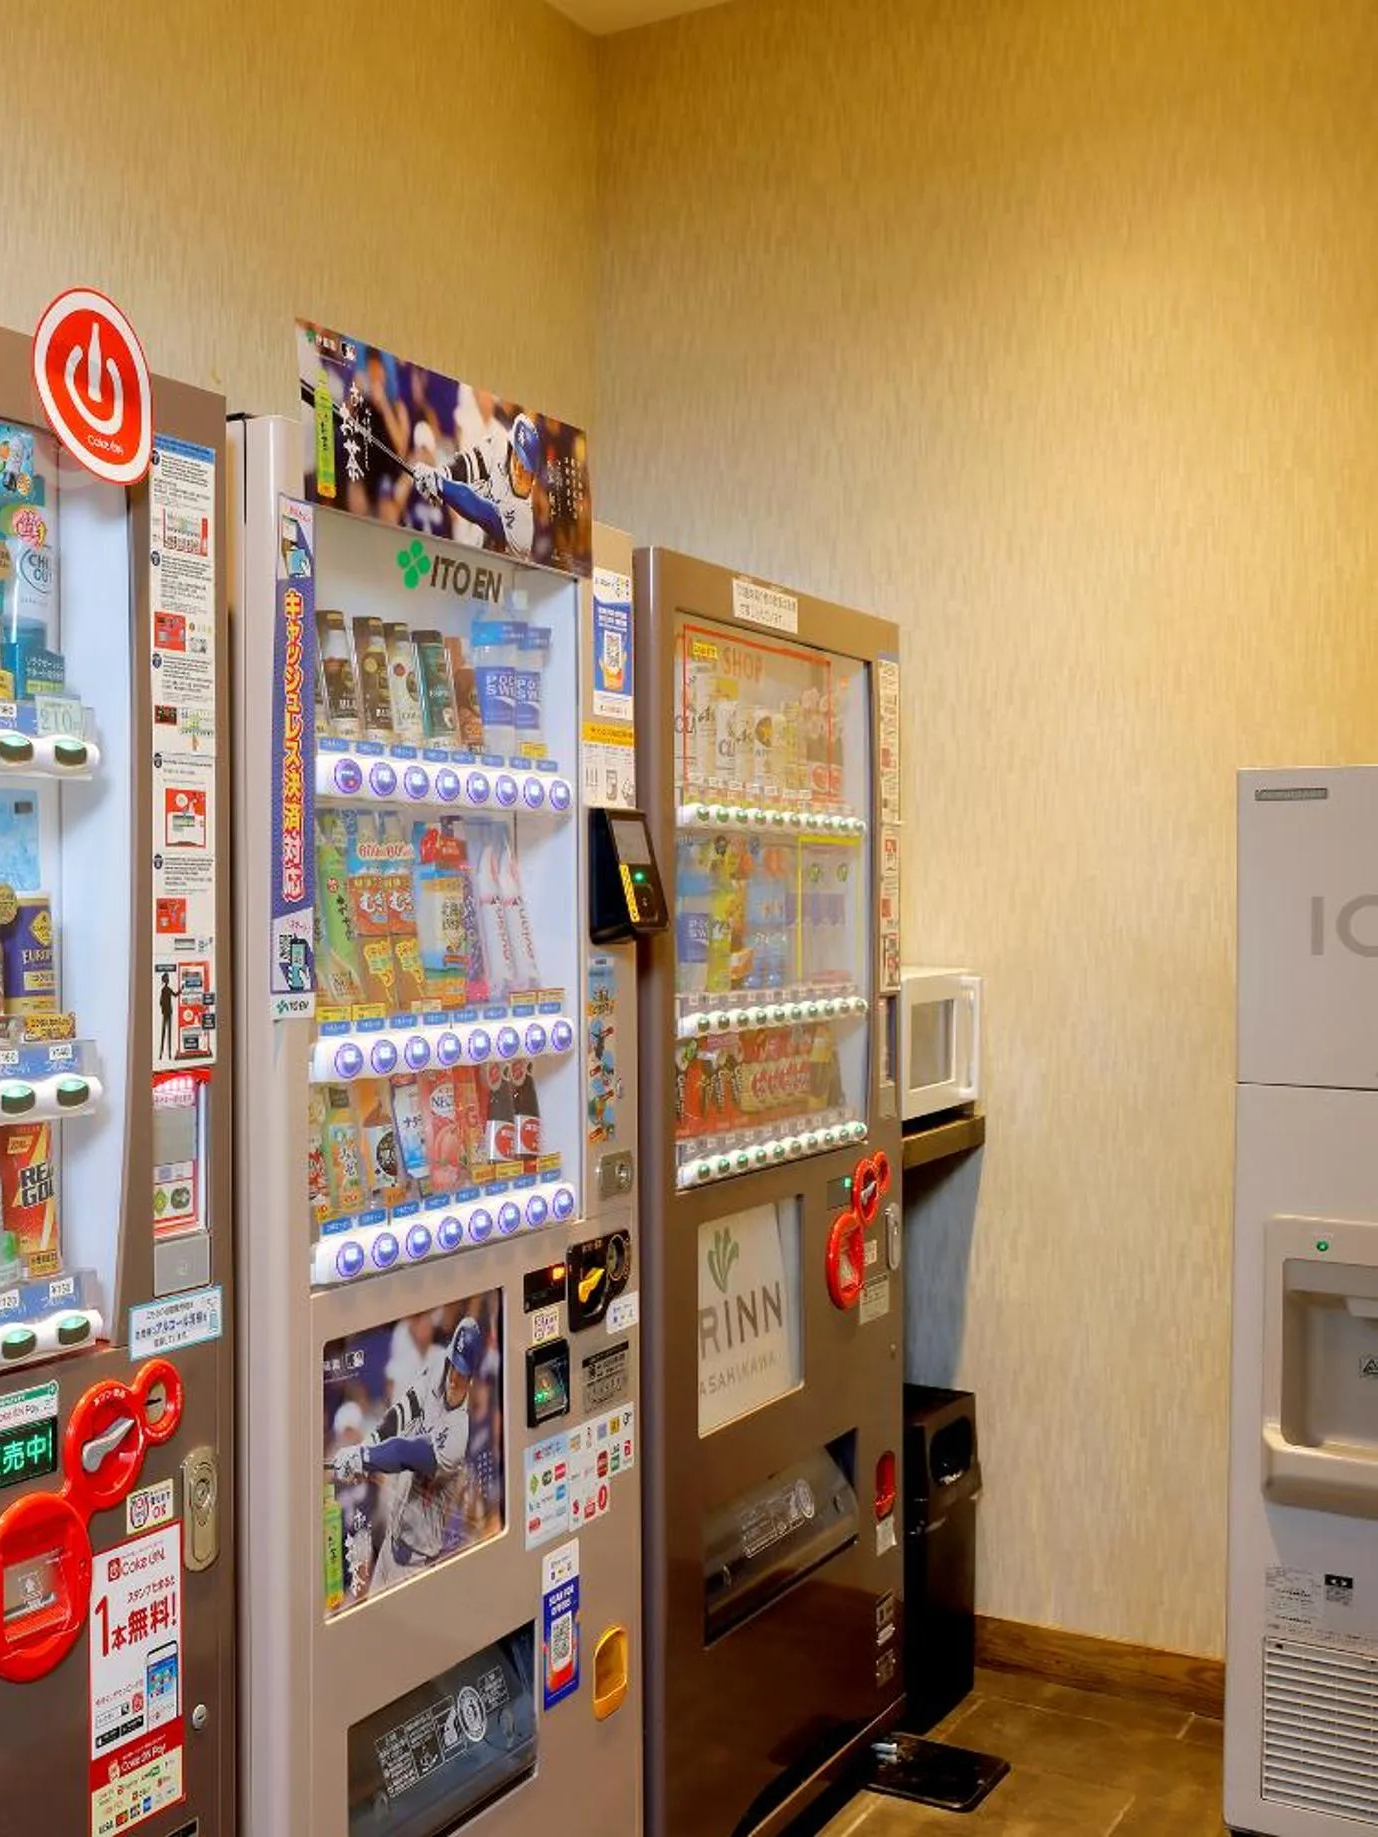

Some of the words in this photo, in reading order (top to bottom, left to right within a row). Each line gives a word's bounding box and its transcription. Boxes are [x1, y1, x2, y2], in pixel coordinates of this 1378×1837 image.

[430, 555, 470, 591] ITO
[471, 564, 502, 603] EN
[724, 1280, 784, 1350] INN
[94, 1592, 177, 1658] 1本無料!
